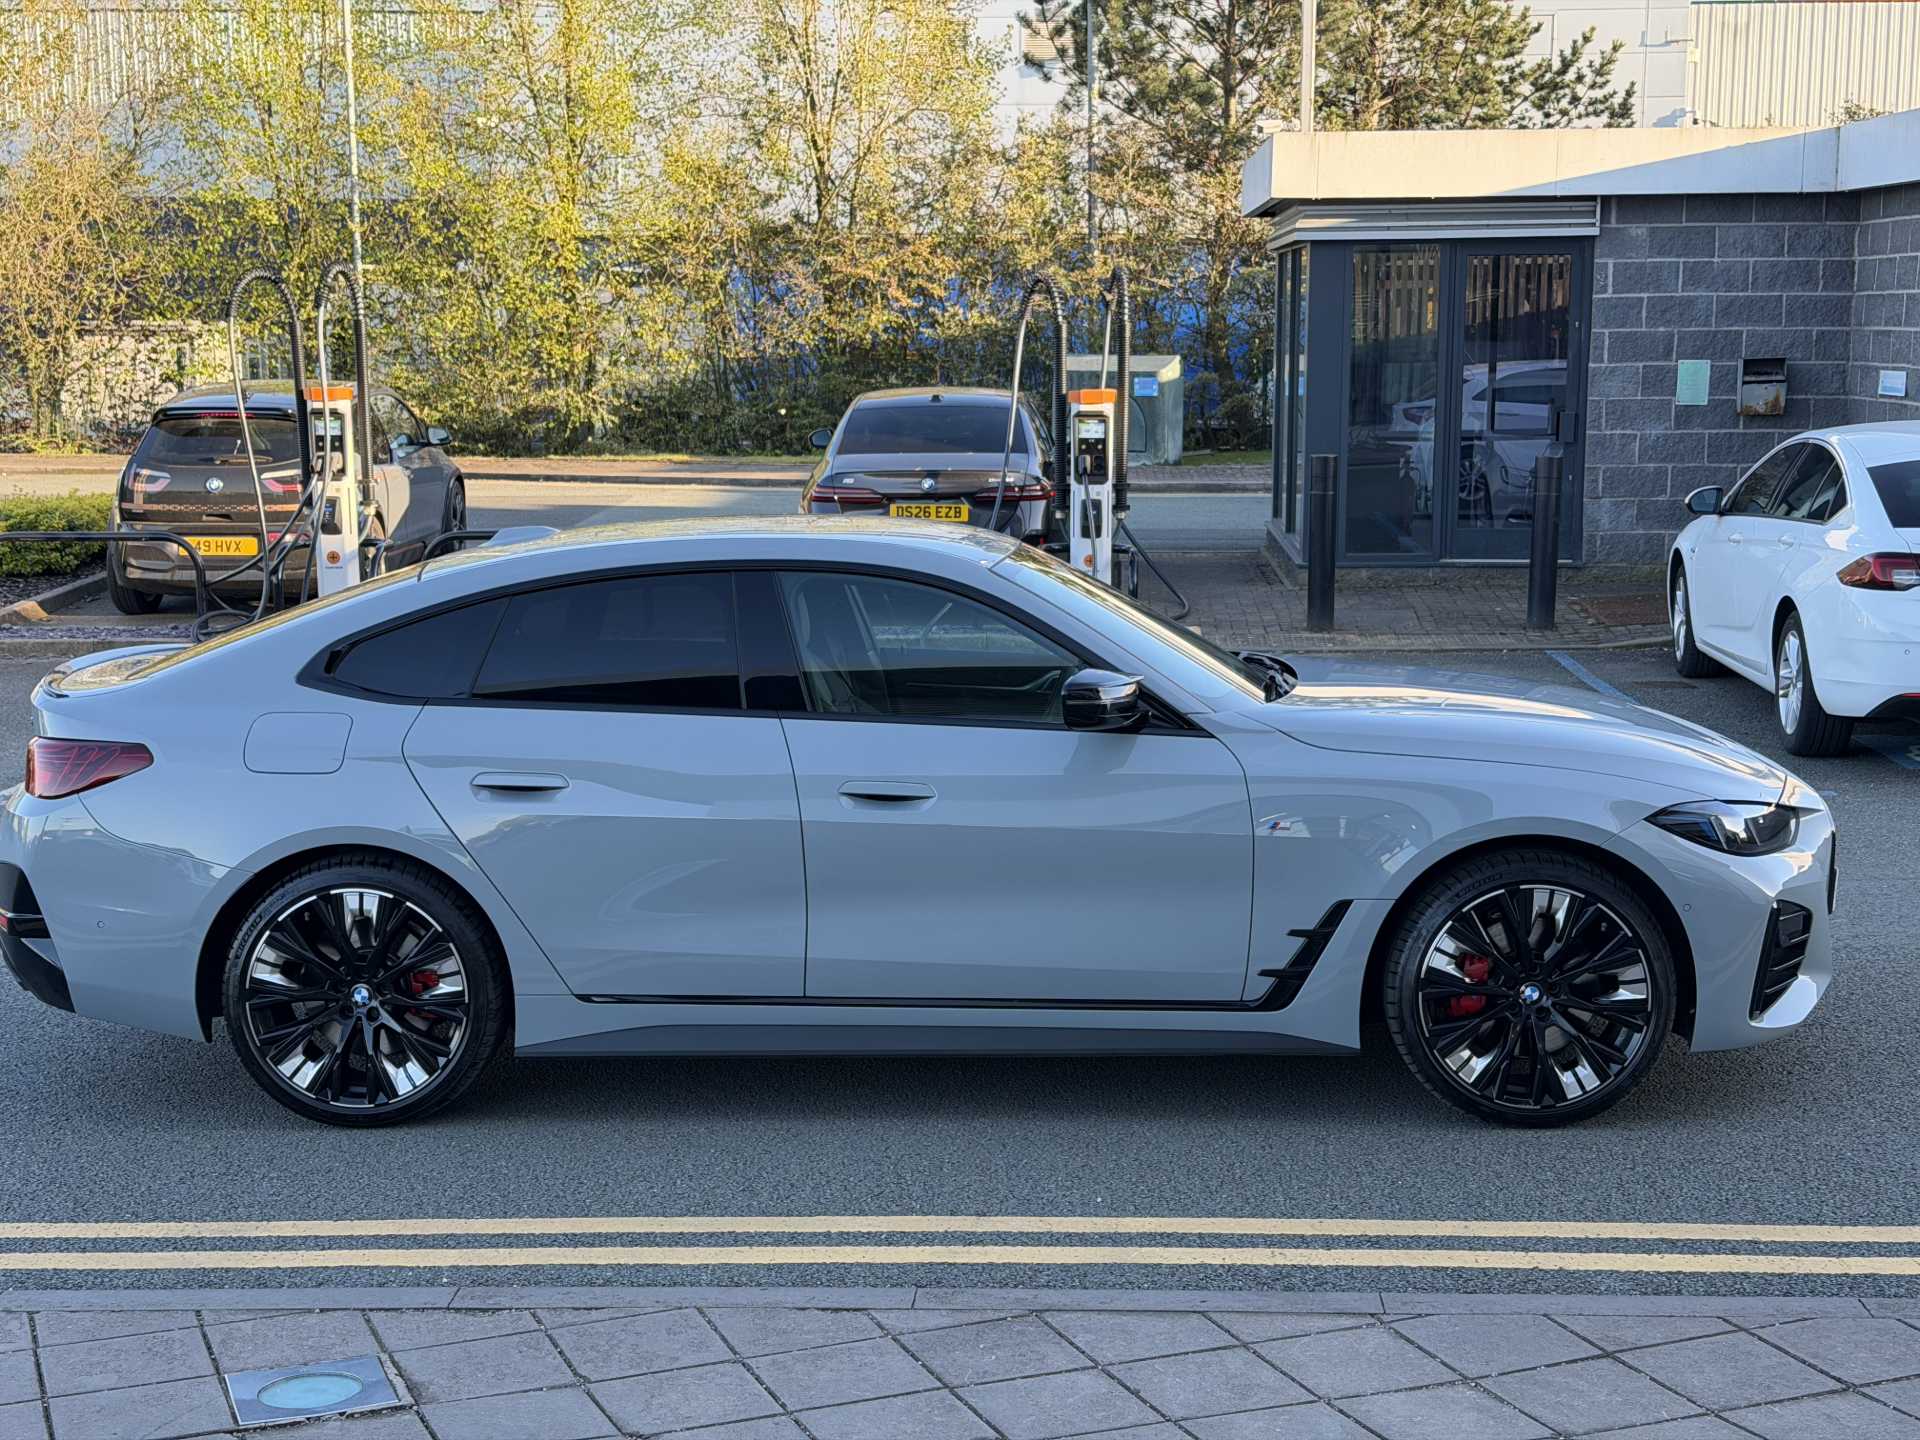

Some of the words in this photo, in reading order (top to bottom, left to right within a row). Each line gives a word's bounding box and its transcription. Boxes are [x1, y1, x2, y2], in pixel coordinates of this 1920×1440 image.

[895, 505, 931, 519] DS26
[935, 506, 962, 519] EZB
[215, 539, 242, 553] HVX
